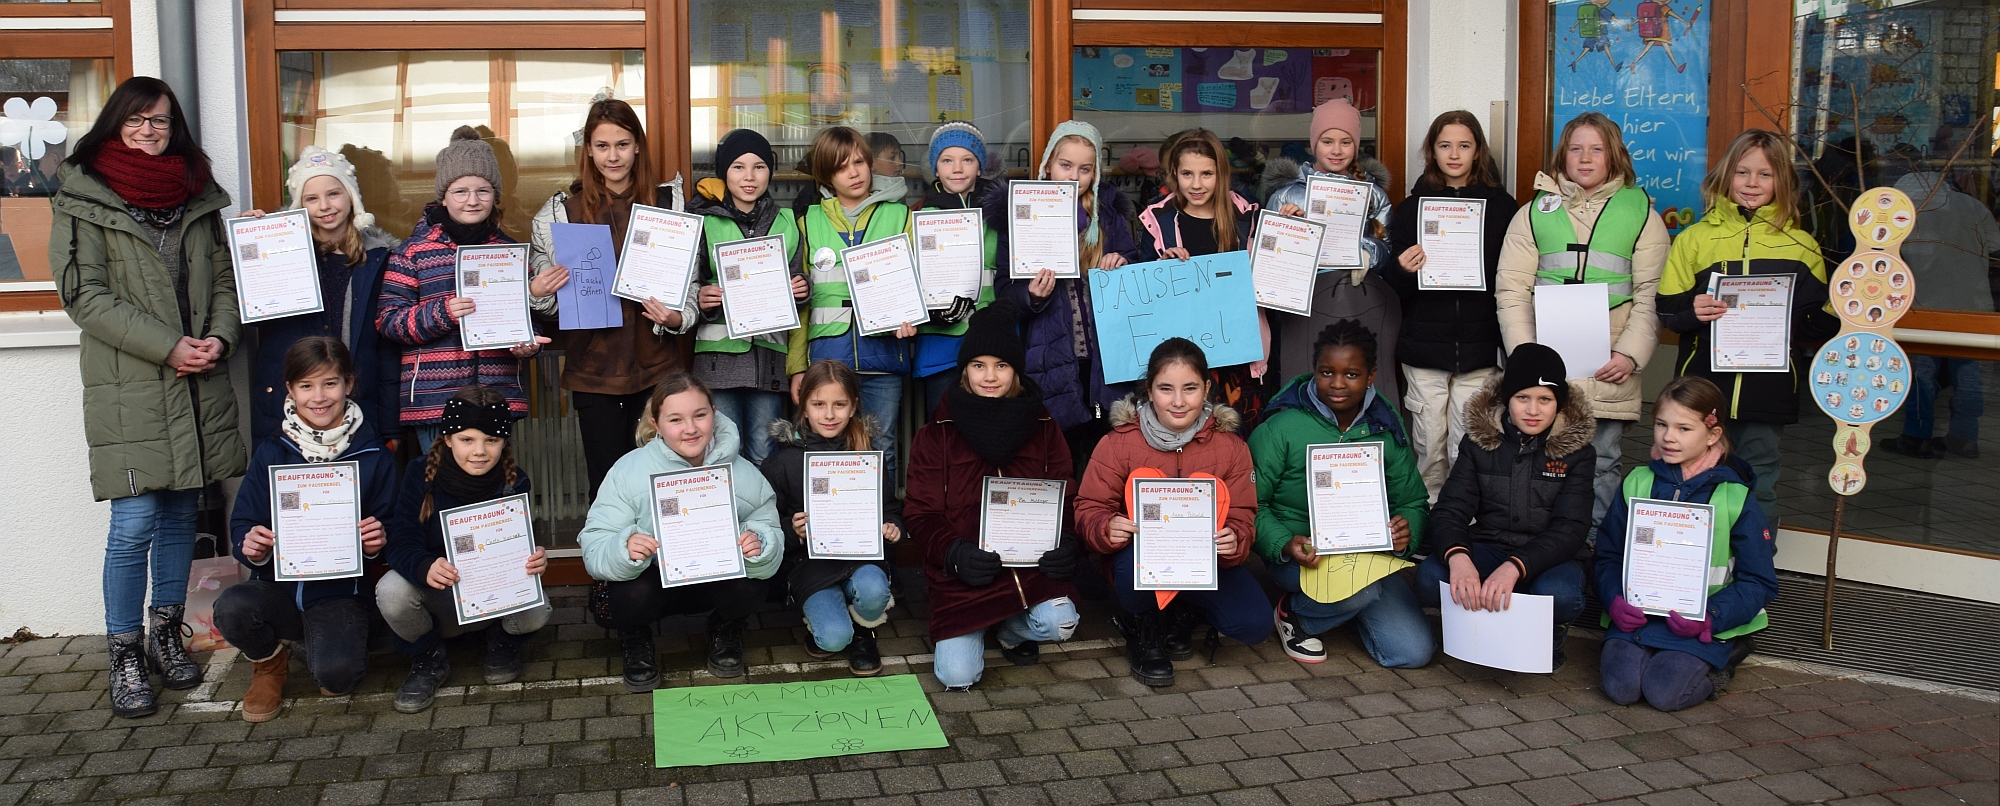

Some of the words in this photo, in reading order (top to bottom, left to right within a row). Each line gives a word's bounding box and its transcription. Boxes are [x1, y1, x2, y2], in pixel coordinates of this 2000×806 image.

[1560, 86, 1615, 107] Liebe
[1624, 85, 1700, 113] Eltern,
[1623, 112, 1666, 134] hier
[1665, 147, 1696, 163] wir
[1635, 168, 1682, 192] eine!
[1312, 185, 1354, 195] BEAUFTRAGUNG
[636, 214, 682, 228] BEAUFTRAGUNG
[918, 218, 963, 227] BEAUFTRAGUNG
[1264, 220, 1307, 233] BEAUFTRAGUNG
[236, 222, 288, 235] BEAUFTRAGUNG
[462, 253, 509, 261] BEAUFTRAGUNG
[721, 245, 766, 258] BEAUFTRAGUNG
[848, 247, 892, 263] BEAUFTRAGUNG
[1093, 259, 1233, 314] PAUSEN-
[1127, 311, 1231, 367] Eel
[1313, 453, 1362, 461] BEAUFTRAGUNG
[1545, 461, 1568, 469] WORLD
[277, 472, 334, 482] BEAUFTRAGUNG
[656, 475, 710, 489] BEAUFTRAGUNG
[449, 509, 506, 526] BEAUFTRAGUNG
[1636, 508, 1690, 520] BEAUFTRAGUNG
[722, 690, 760, 706] IM
[780, 678, 900, 700] MONAT
